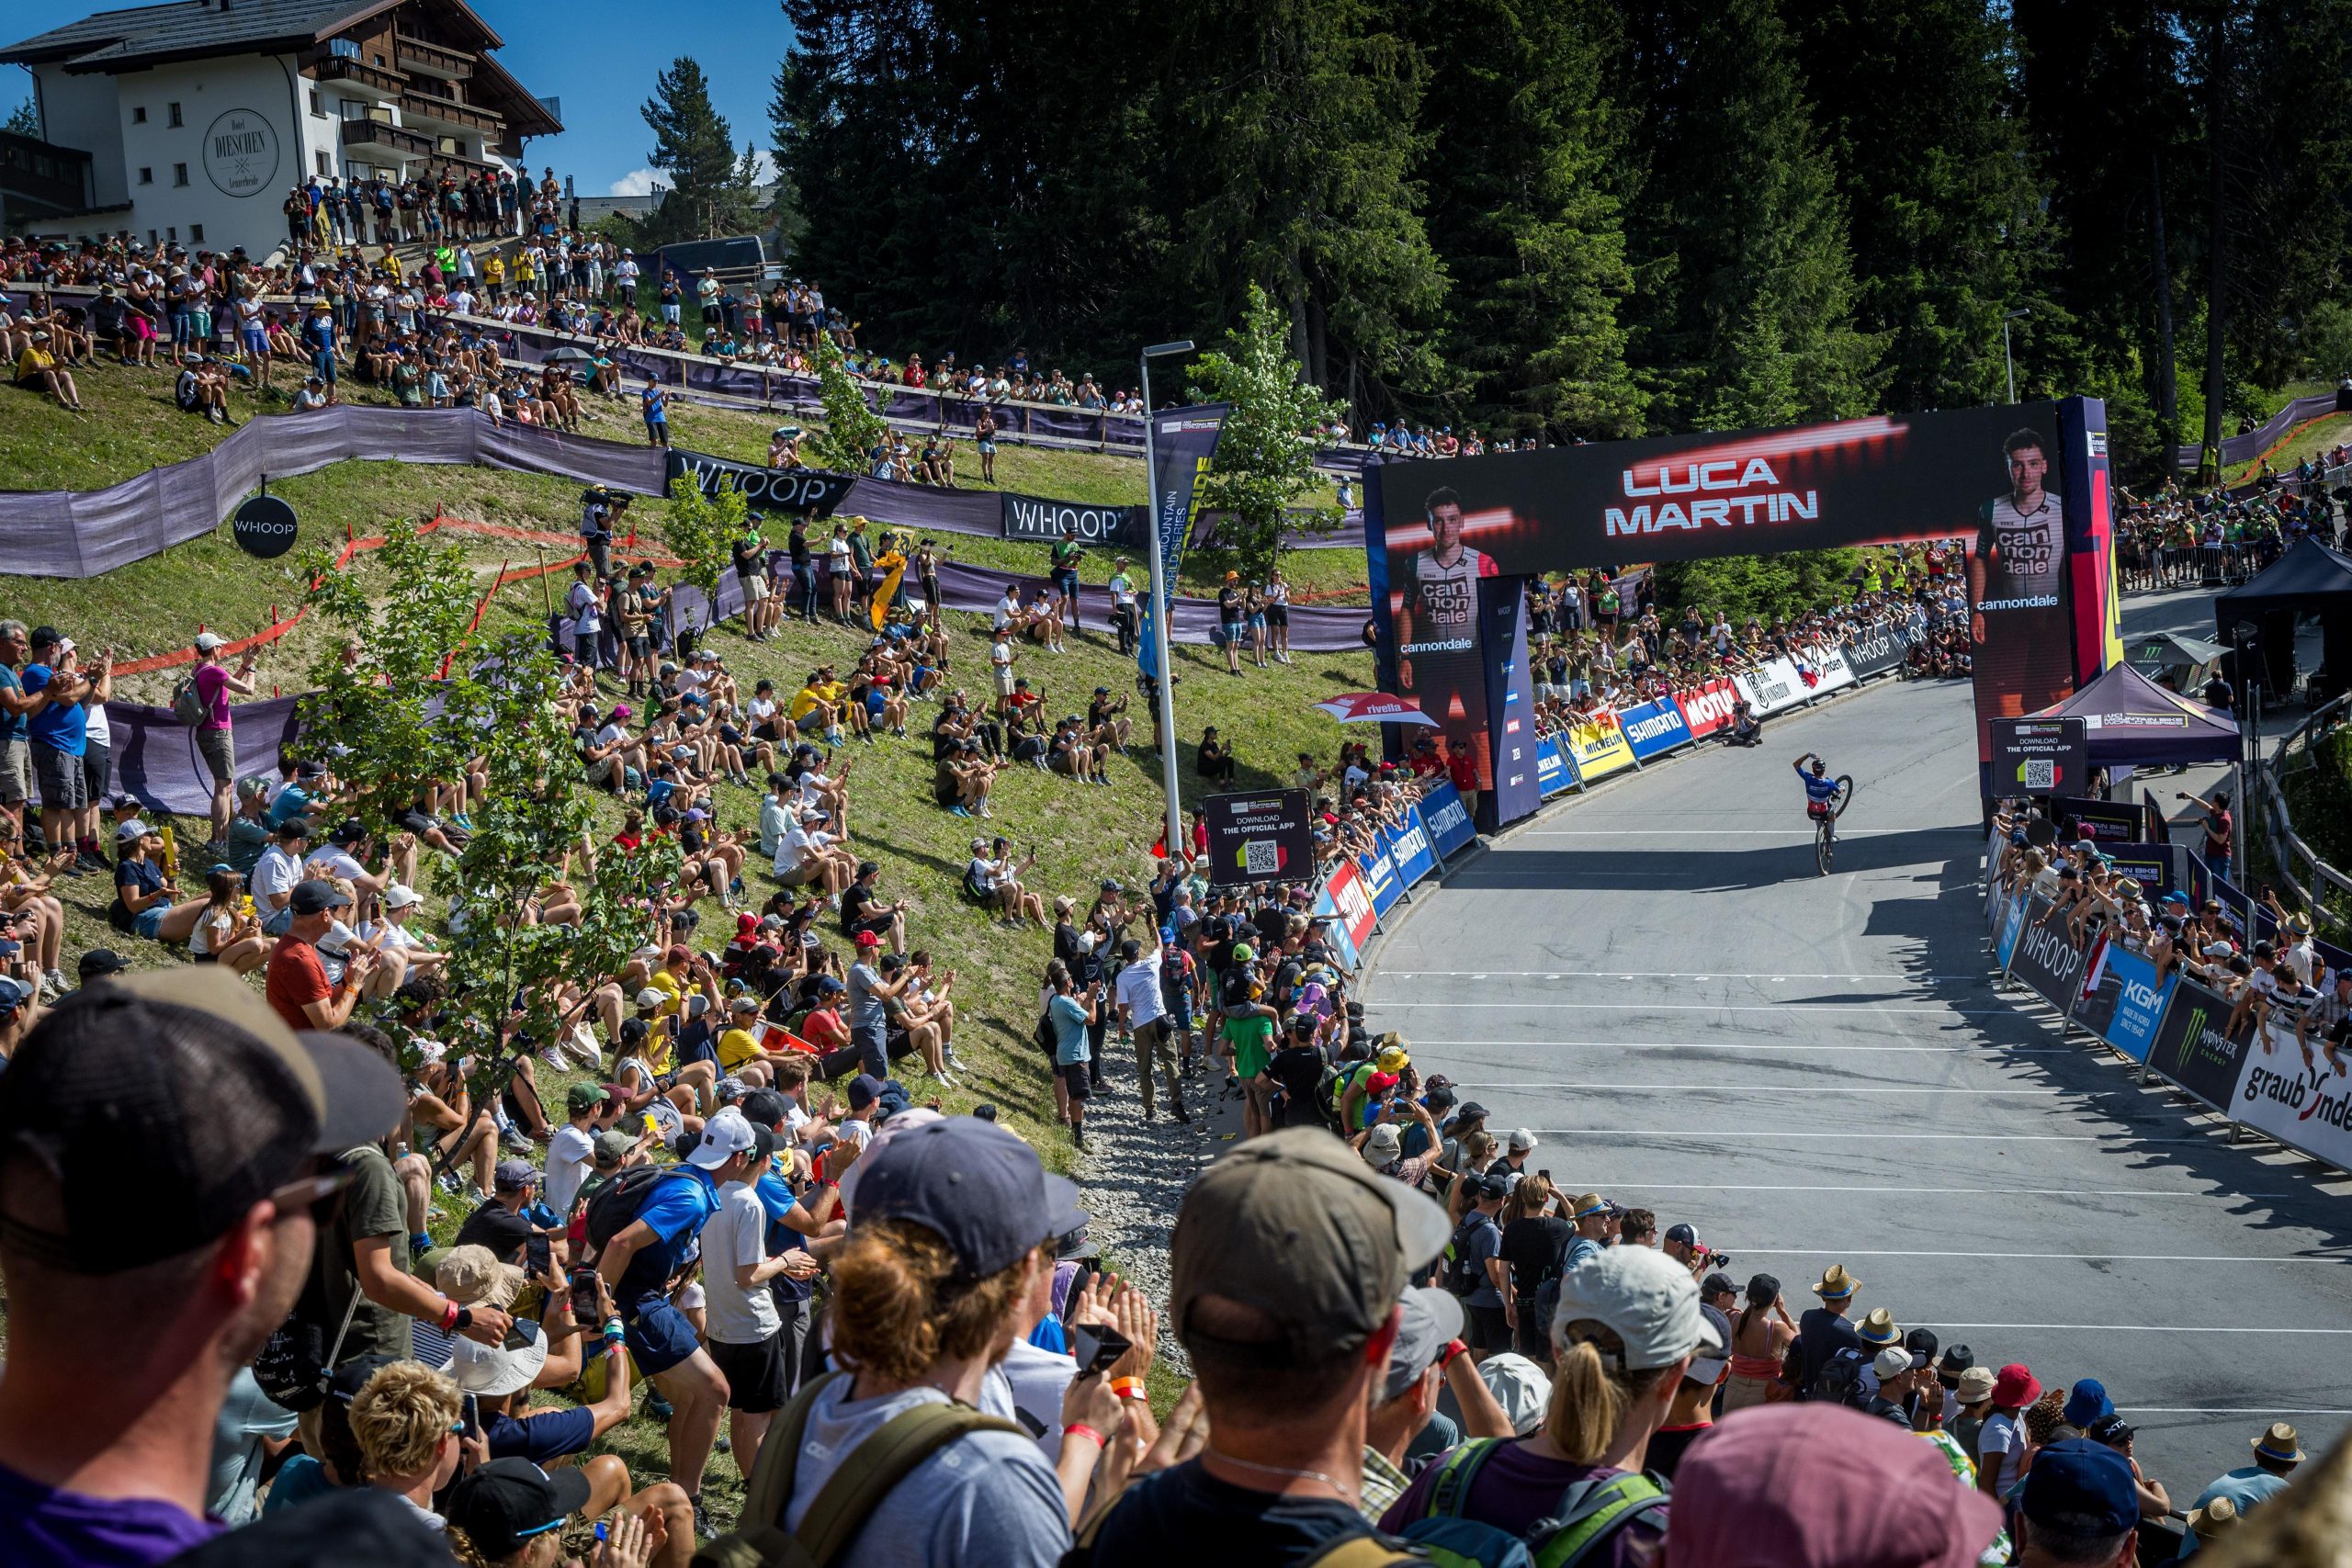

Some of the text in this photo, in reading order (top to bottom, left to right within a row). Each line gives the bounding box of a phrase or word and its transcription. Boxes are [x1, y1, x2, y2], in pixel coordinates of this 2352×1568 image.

[215, 130, 266, 158] DIESCHEN
[682, 457, 826, 505] WHOOP
[1623, 458, 1734, 497] LUCA
[1013, 501, 1117, 538] WHOOP
[1605, 491, 1818, 536] MARTIN
[234, 520, 294, 535] WHOOP
[1997, 529, 2050, 546] can
[1164, 507, 1186, 599] WORLD SERIES
[2004, 545, 2051, 559] non
[2003, 558, 2048, 575] dale
[1422, 580, 1469, 597] can
[1428, 597, 1470, 609] non
[1976, 594, 2058, 611] cannondale
[1428, 609, 1467, 624] dale
[1400, 637, 1472, 653] cannondale
[1849, 637, 1889, 664] WHOOP
[1367, 703, 1402, 714] rivella
[1626, 710, 1683, 743] SHIMANO
[1585, 734, 1623, 754] MICHELIN
[1236, 815, 1280, 825] DOWNLOAD
[1427, 798, 1467, 839] SHIMANO
[2109, 823, 2128, 831] BIKE
[1241, 824, 1277, 834] OFFICIAL
[1391, 826, 1427, 867] SHIMANO
[1337, 874, 1370, 935] MOTUL
[2023, 919, 2079, 982] WHOOP
[2124, 978, 2164, 1014] KGM
[2122, 1006, 2133, 1019] MADE
[2200, 1048, 2226, 1066] ENERGY
[2104, 1419, 2127, 1437] XTR
